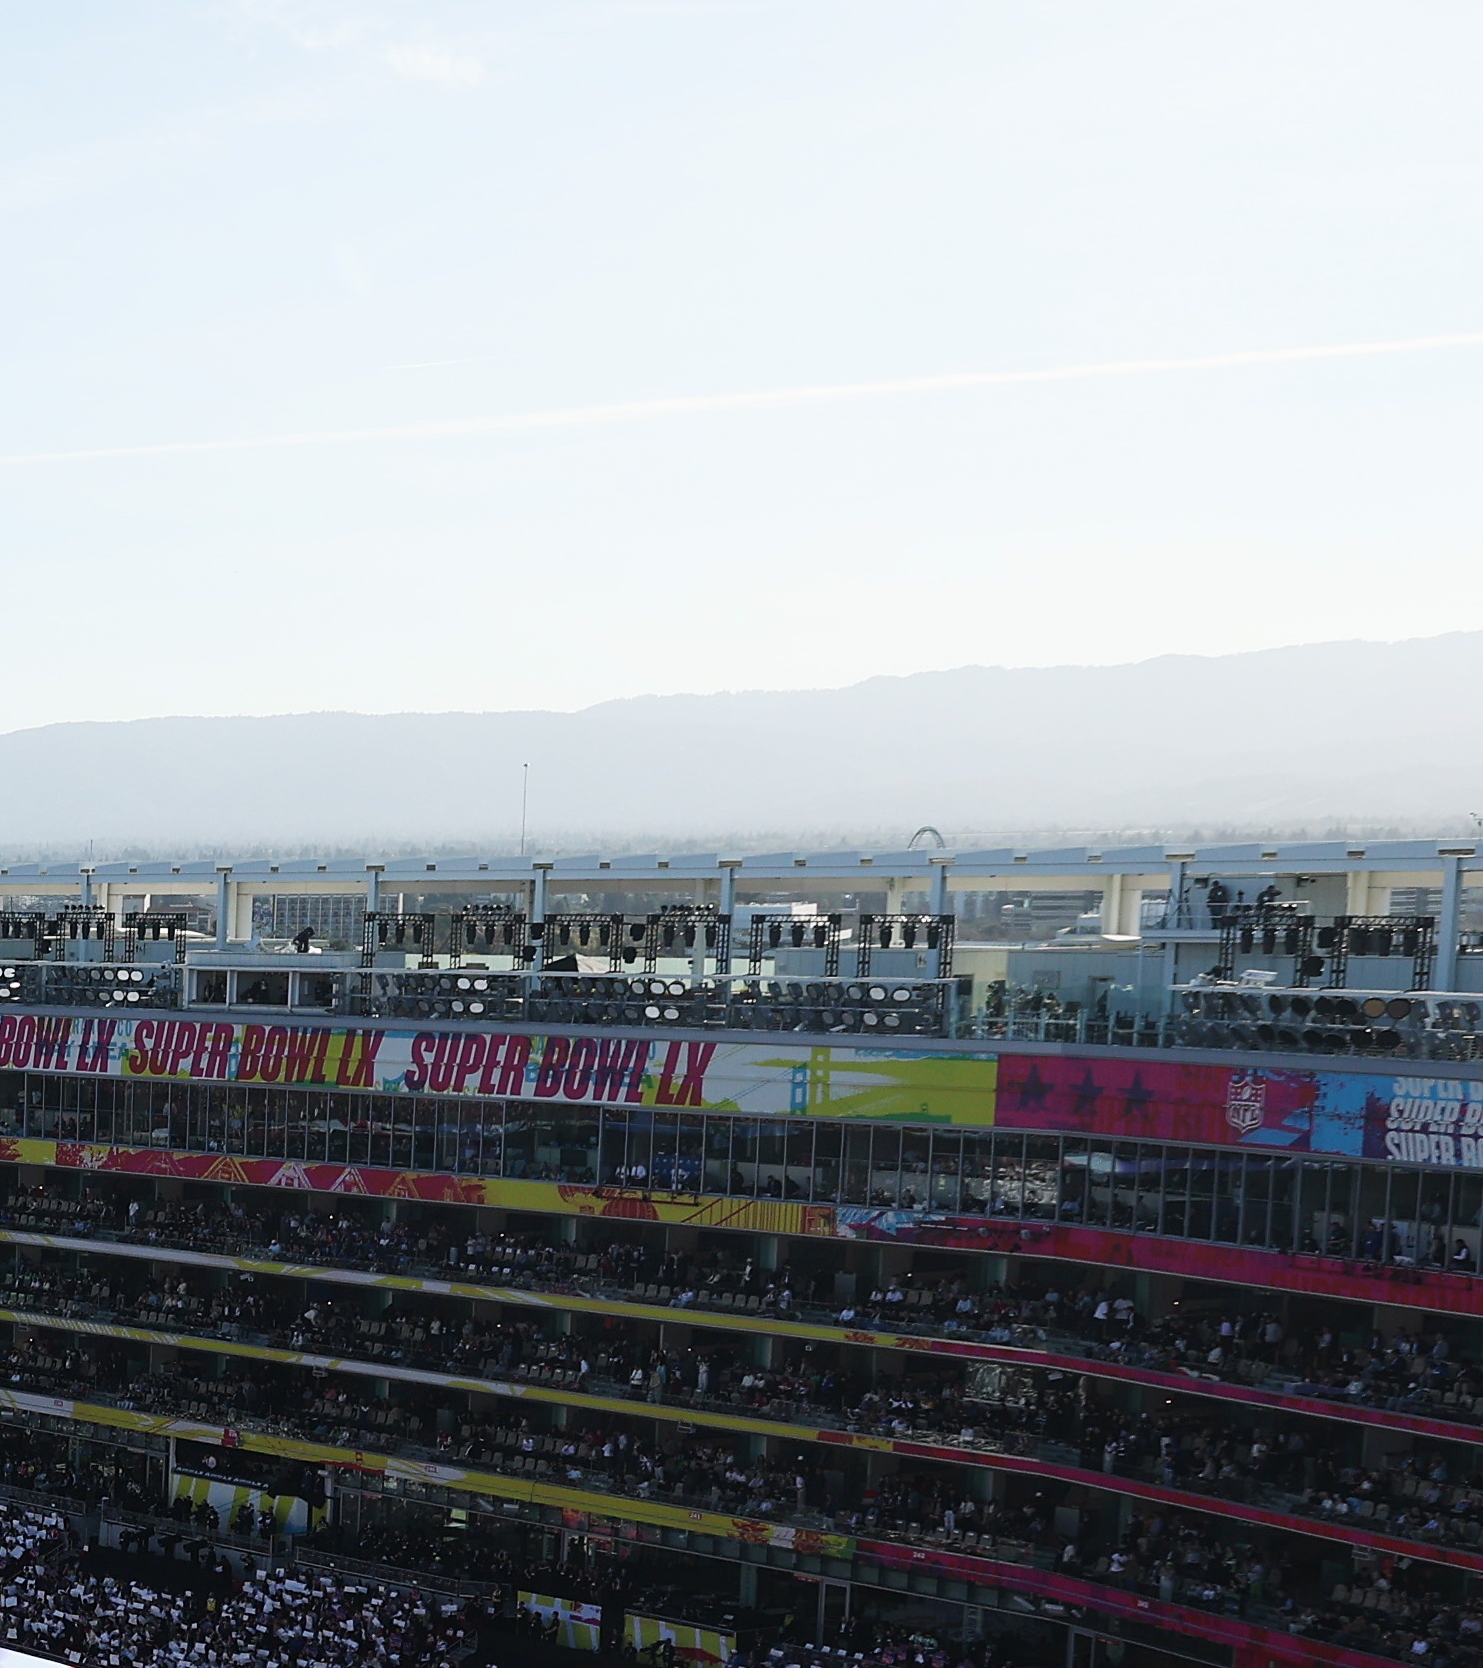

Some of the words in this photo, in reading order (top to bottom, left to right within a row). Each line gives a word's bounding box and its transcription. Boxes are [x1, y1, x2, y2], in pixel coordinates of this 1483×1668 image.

[75, 1018, 118, 1074] LX
[129, 1019, 235, 1080] SUPER
[237, 1024, 333, 1085] BOWL
[336, 1029, 386, 1089] LX
[405, 1031, 532, 1097] SUPER
[534, 1036, 649, 1106] BOWL
[654, 1040, 718, 1107] LX
